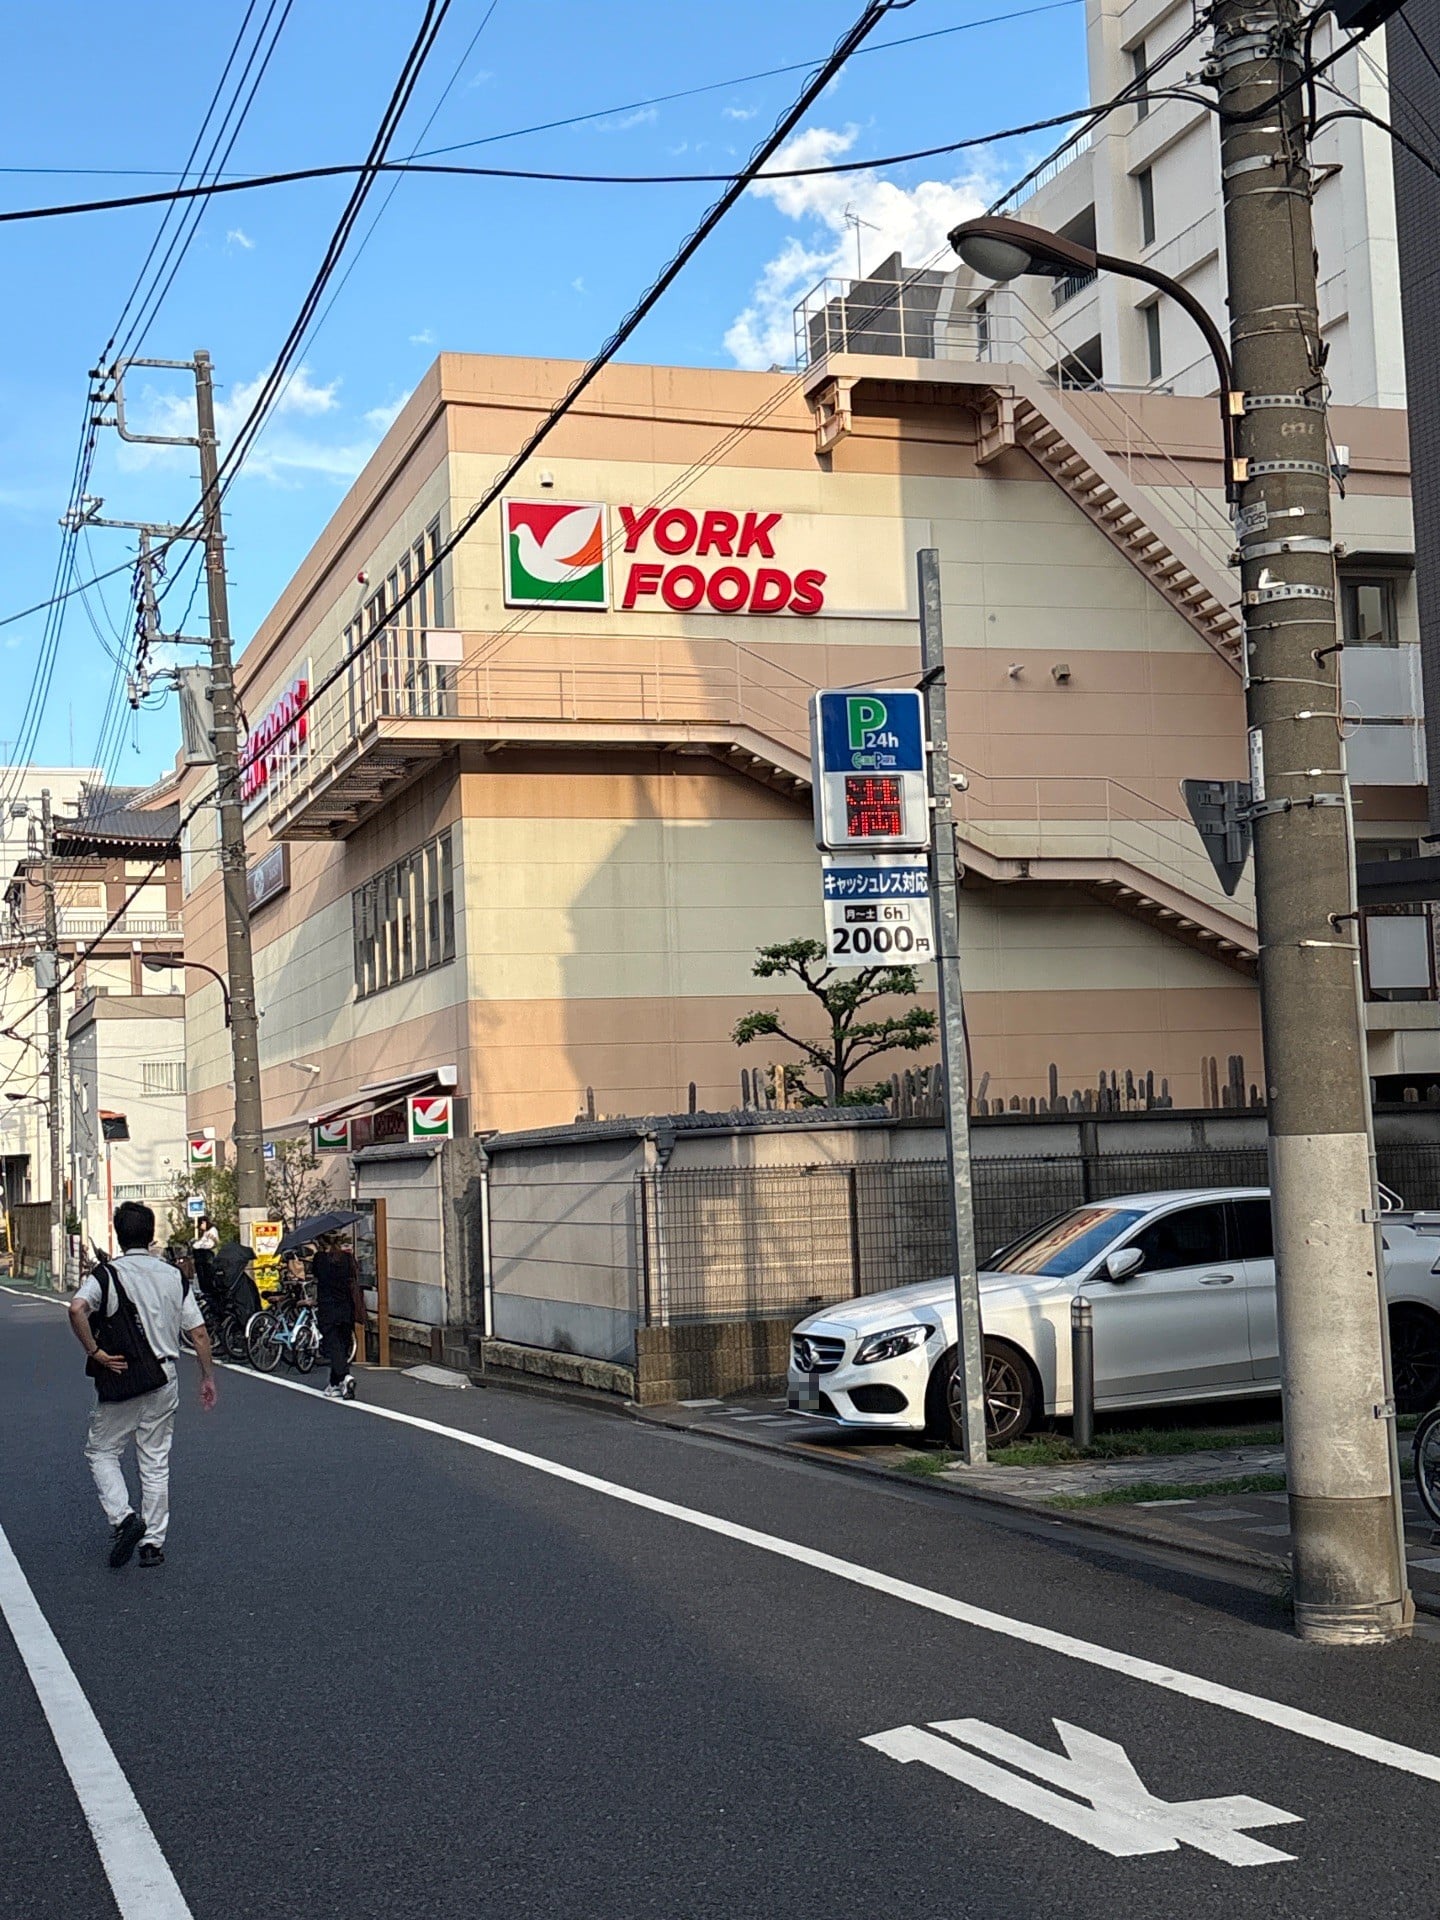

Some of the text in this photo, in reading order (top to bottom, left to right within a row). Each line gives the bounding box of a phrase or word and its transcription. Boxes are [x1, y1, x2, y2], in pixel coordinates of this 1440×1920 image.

[618, 506, 783, 559] YORK
[621, 563, 828, 615] FOODS
[846, 696, 888, 750] P
[866, 731, 899, 748] 24h
[846, 779, 902, 837] 満
[824, 871, 929, 895] キャッシュレス対応
[883, 906, 904, 920] 6h
